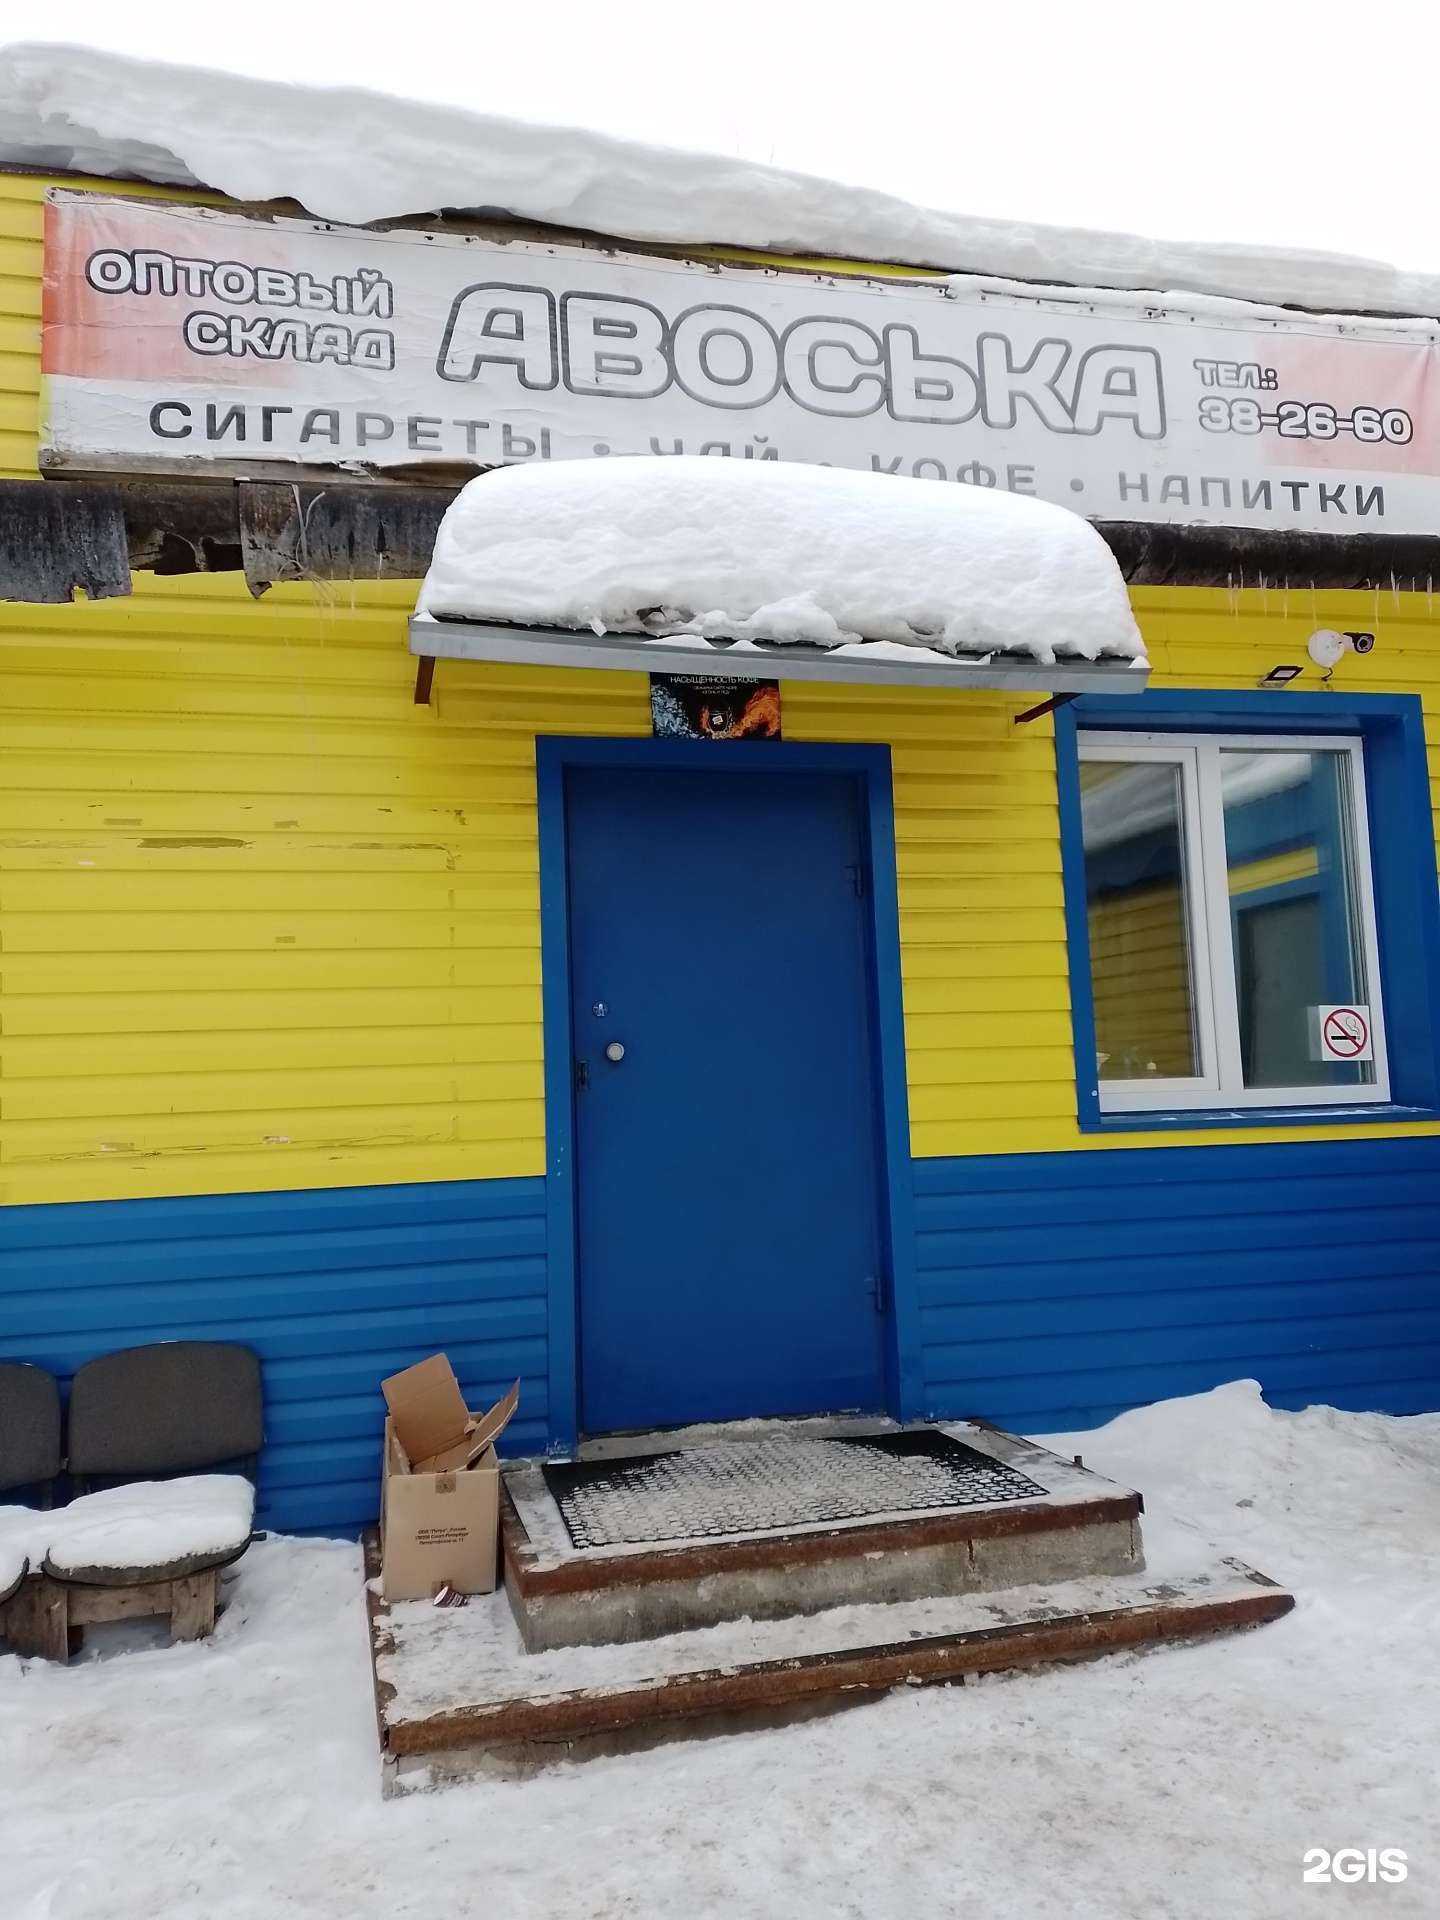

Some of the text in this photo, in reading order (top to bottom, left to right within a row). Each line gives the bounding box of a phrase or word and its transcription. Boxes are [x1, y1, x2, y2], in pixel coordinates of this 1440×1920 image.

[85, 249, 393, 319] ОПТОВЫЙ
[183, 310, 395, 370] СКЛАД
[436, 282, 1167, 441] АВОСЬКА
[1193, 358, 1279, 390] ТЕЛ.:
[1199, 395, 1414, 445] 38-26-60
[149, 401, 550, 460] СИГАРЕТЫ
[870, 454, 1038, 496] КОФЕ
[1118, 471, 1385, 517] НАПИТКИ
